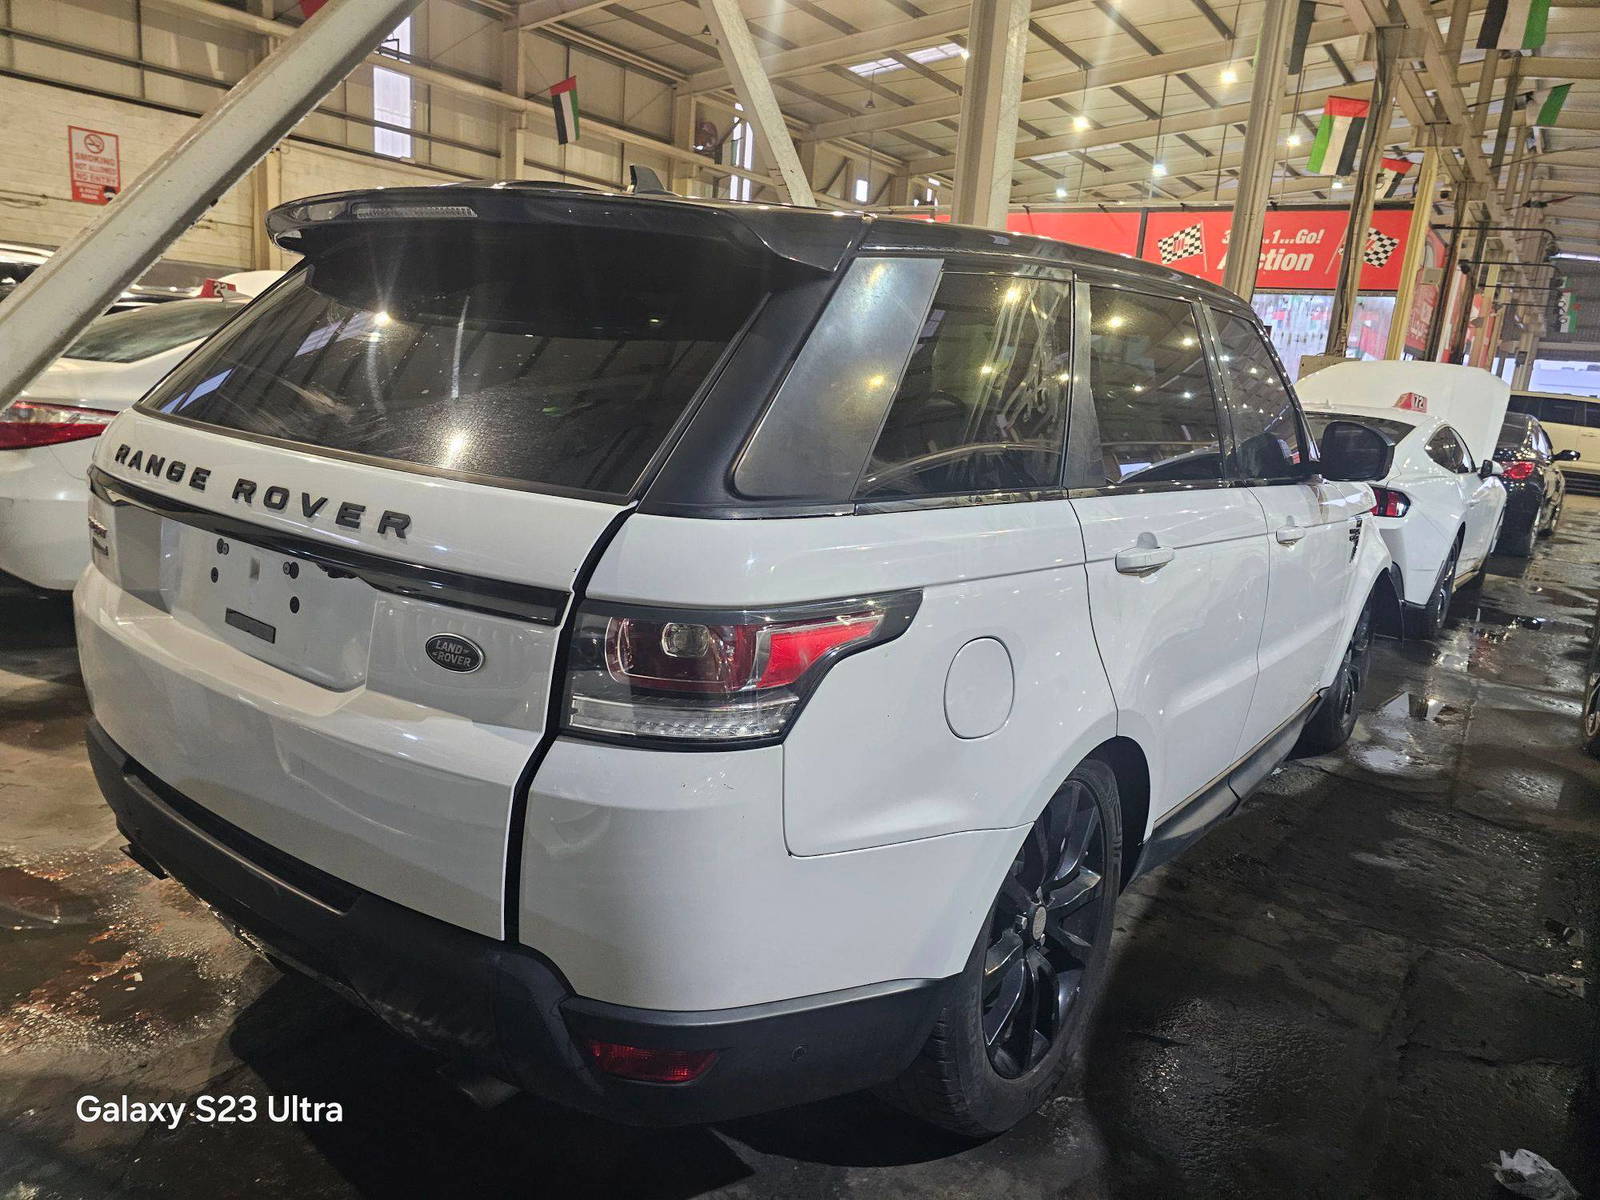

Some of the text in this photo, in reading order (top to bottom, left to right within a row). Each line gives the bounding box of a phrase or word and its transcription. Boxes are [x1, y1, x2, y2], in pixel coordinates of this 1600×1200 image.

[75, 152, 115, 166] SMOKING
[76, 172, 116, 184] NO ENTRY
[115, 443, 412, 539] RANGE ROVER
[436, 640, 463, 654] LAND
[437, 651, 471, 667] ROVER
